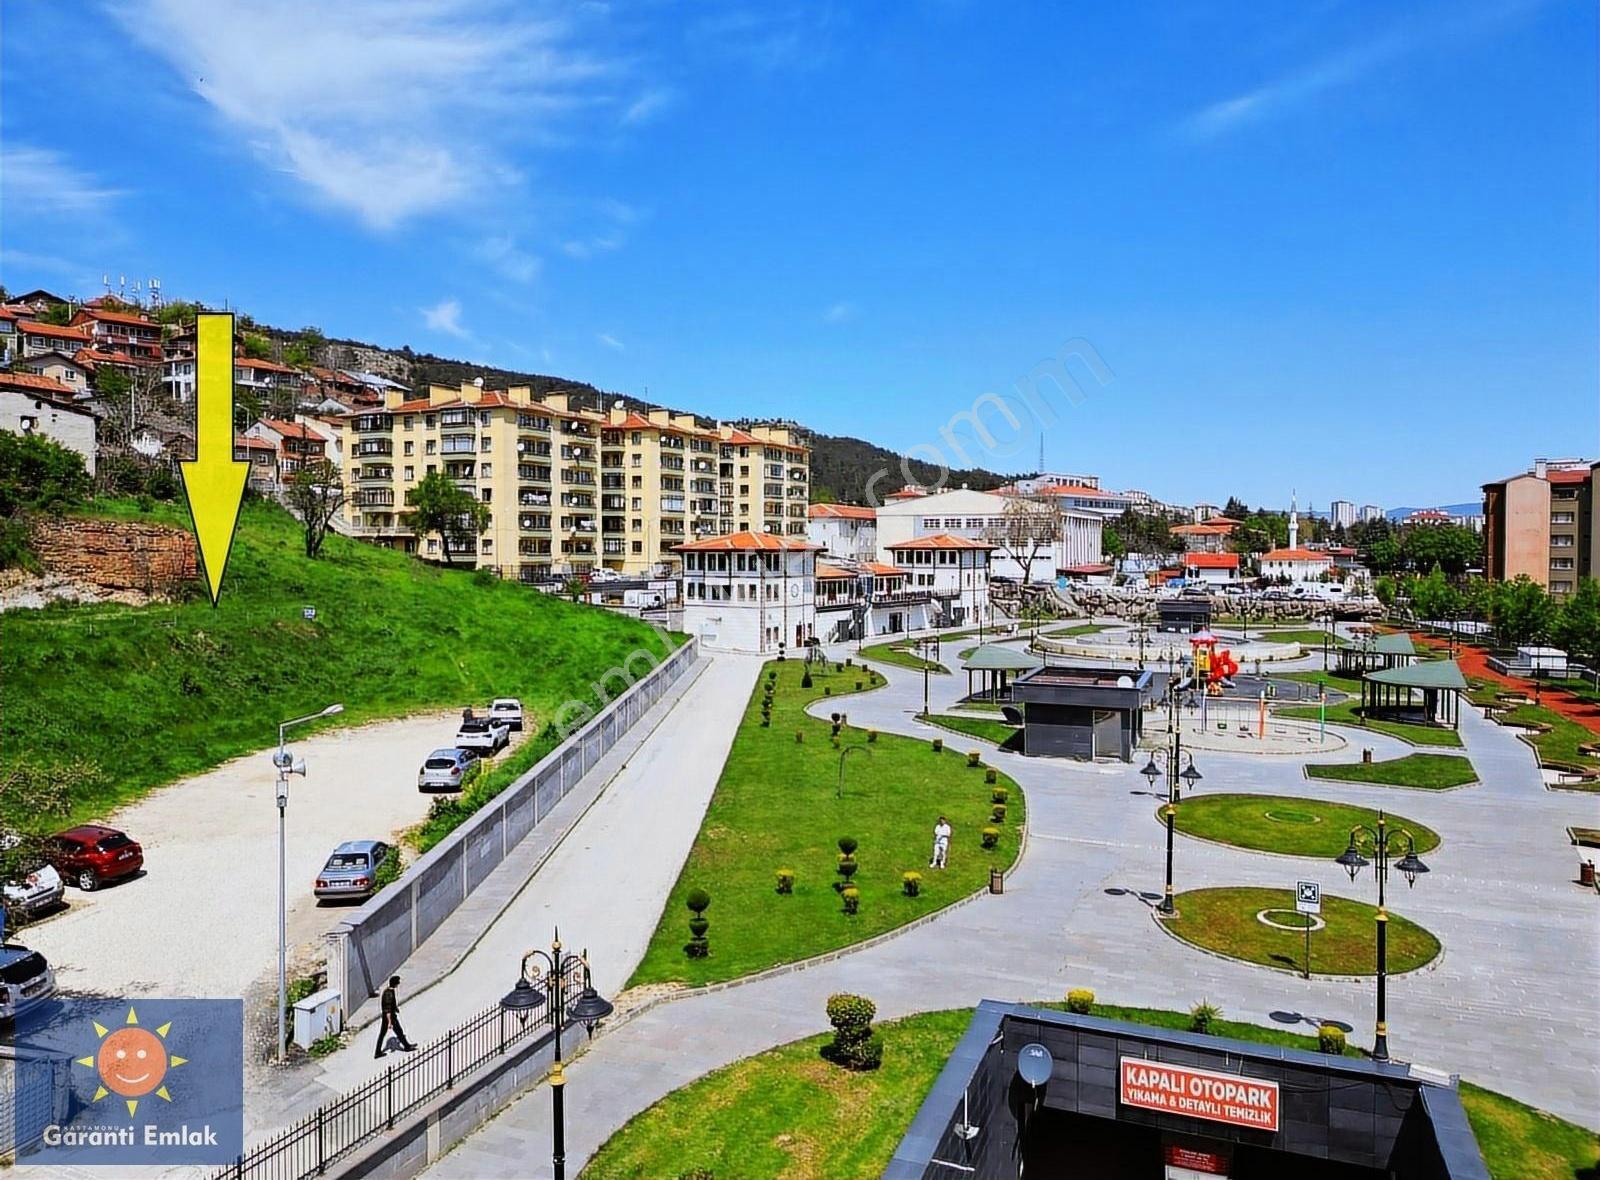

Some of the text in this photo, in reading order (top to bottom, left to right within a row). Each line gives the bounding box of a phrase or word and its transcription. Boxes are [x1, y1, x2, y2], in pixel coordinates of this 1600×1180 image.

[1126, 1066, 1272, 1108] KAPALI OTOPARK
[1127, 1087, 1167, 1106] YIKAMA
[1169, 1095, 1177, 1107] &
[1178, 1096, 1221, 1116] DETAYLI
